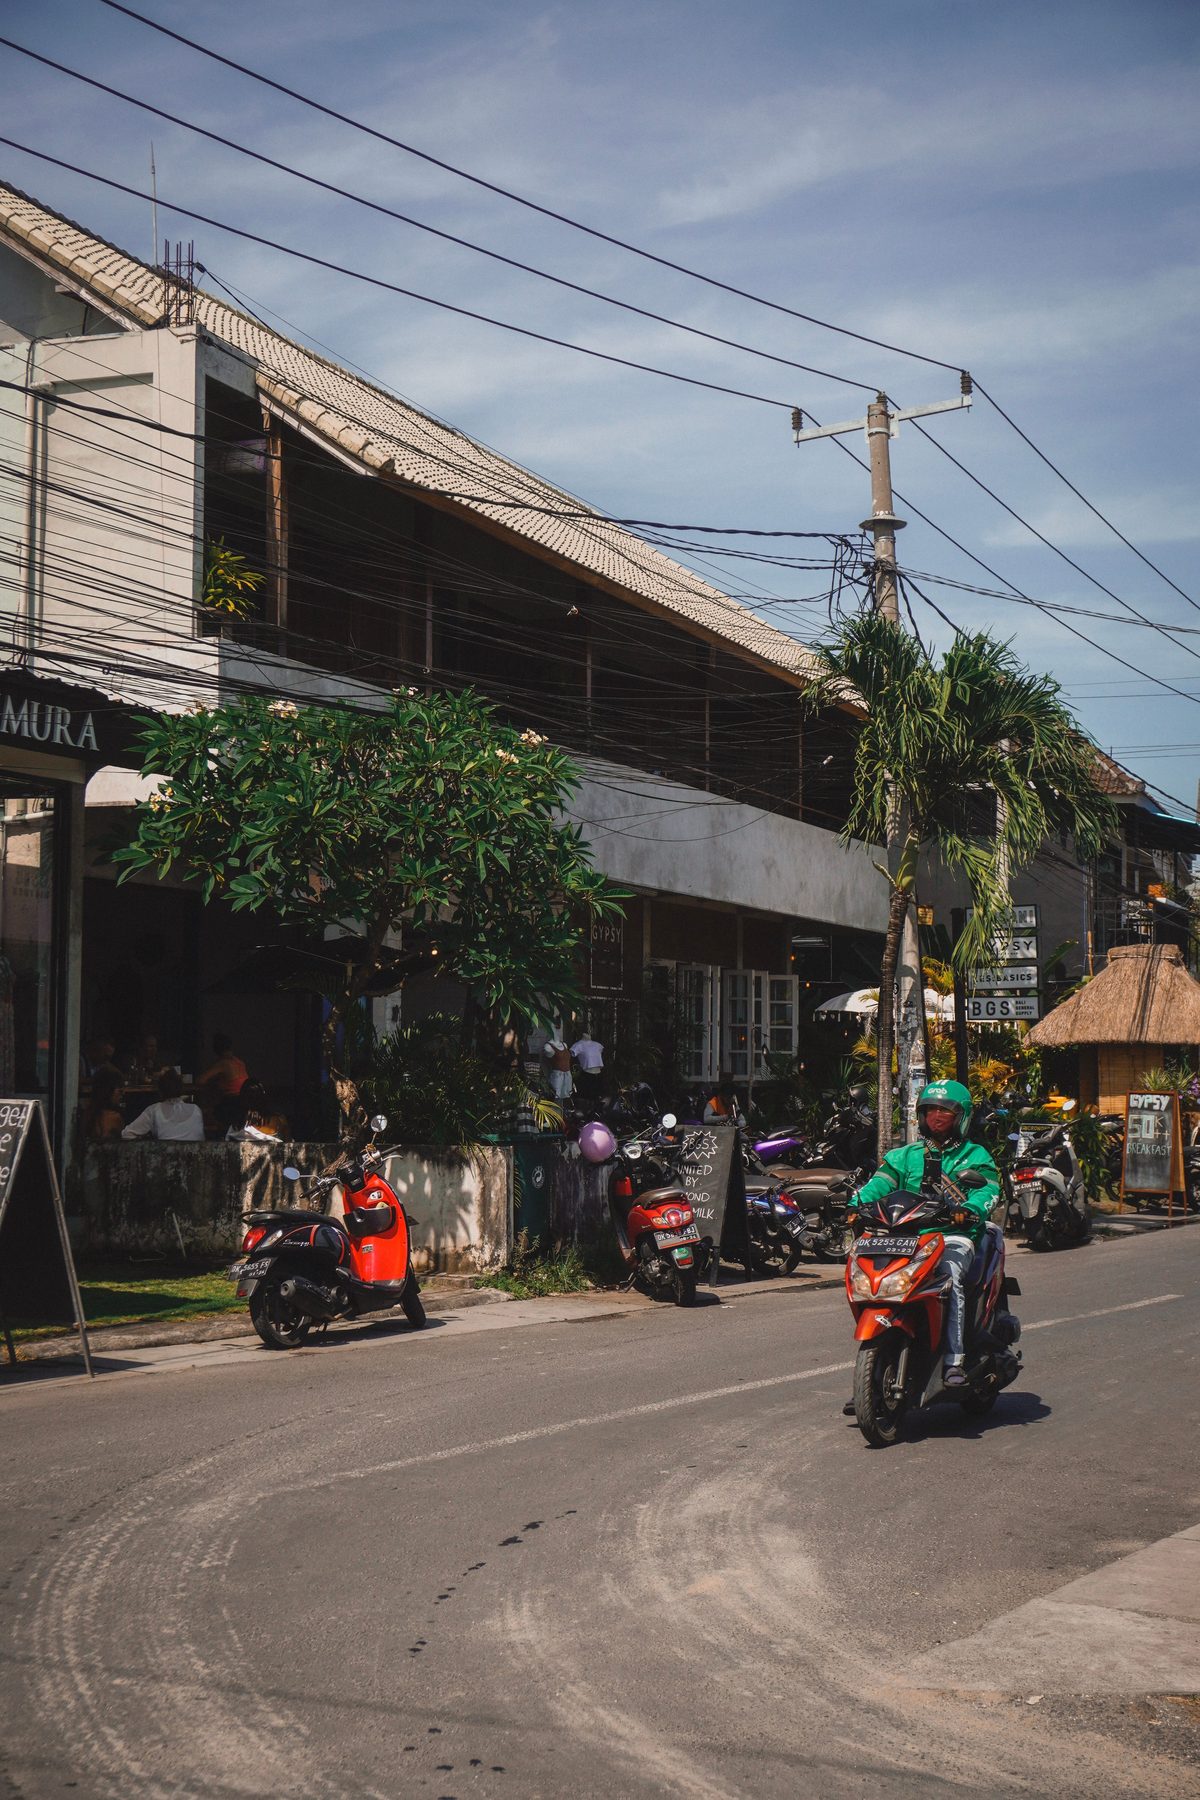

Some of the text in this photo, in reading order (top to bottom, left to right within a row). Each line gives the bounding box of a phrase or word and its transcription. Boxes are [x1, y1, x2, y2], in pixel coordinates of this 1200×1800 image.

[0, 694, 100, 752] MURA
[592, 924, 621, 943] GYPSY
[972, 1001, 1010, 1016] BGS
[927, 1087, 948, 1095] Grab
[1129, 1094, 1170, 1111] GYPSY
[688, 1138, 710, 1150] BGS
[1126, 1142, 1172, 1156] BREAKFAST
[677, 1164, 713, 1176] UNITED
[685, 1192, 711, 1202] OND
[858, 1239, 871, 1247] DK
[896, 1239, 916, 1247] CAH
